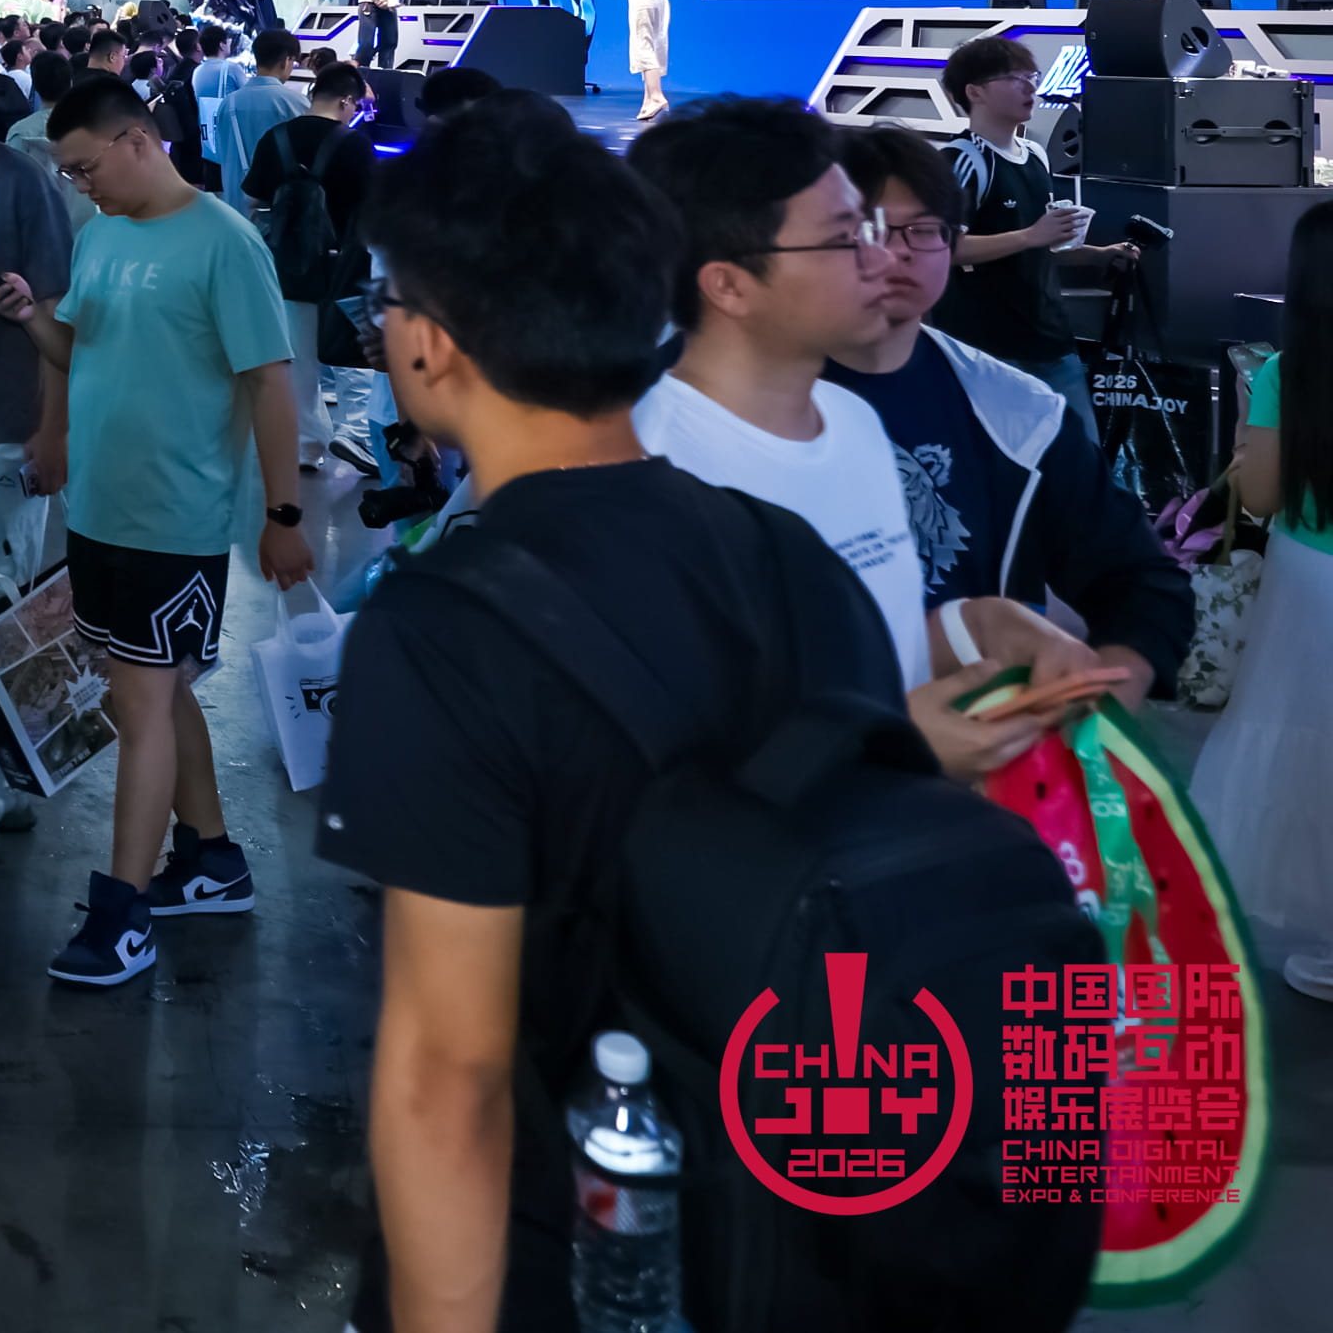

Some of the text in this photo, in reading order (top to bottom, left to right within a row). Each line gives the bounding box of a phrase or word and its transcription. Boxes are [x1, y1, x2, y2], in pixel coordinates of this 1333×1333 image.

[80, 260, 165, 289] NIKE
[1093, 374, 1138, 389] 2026
[1093, 392, 1188, 414] CHINAJOY
